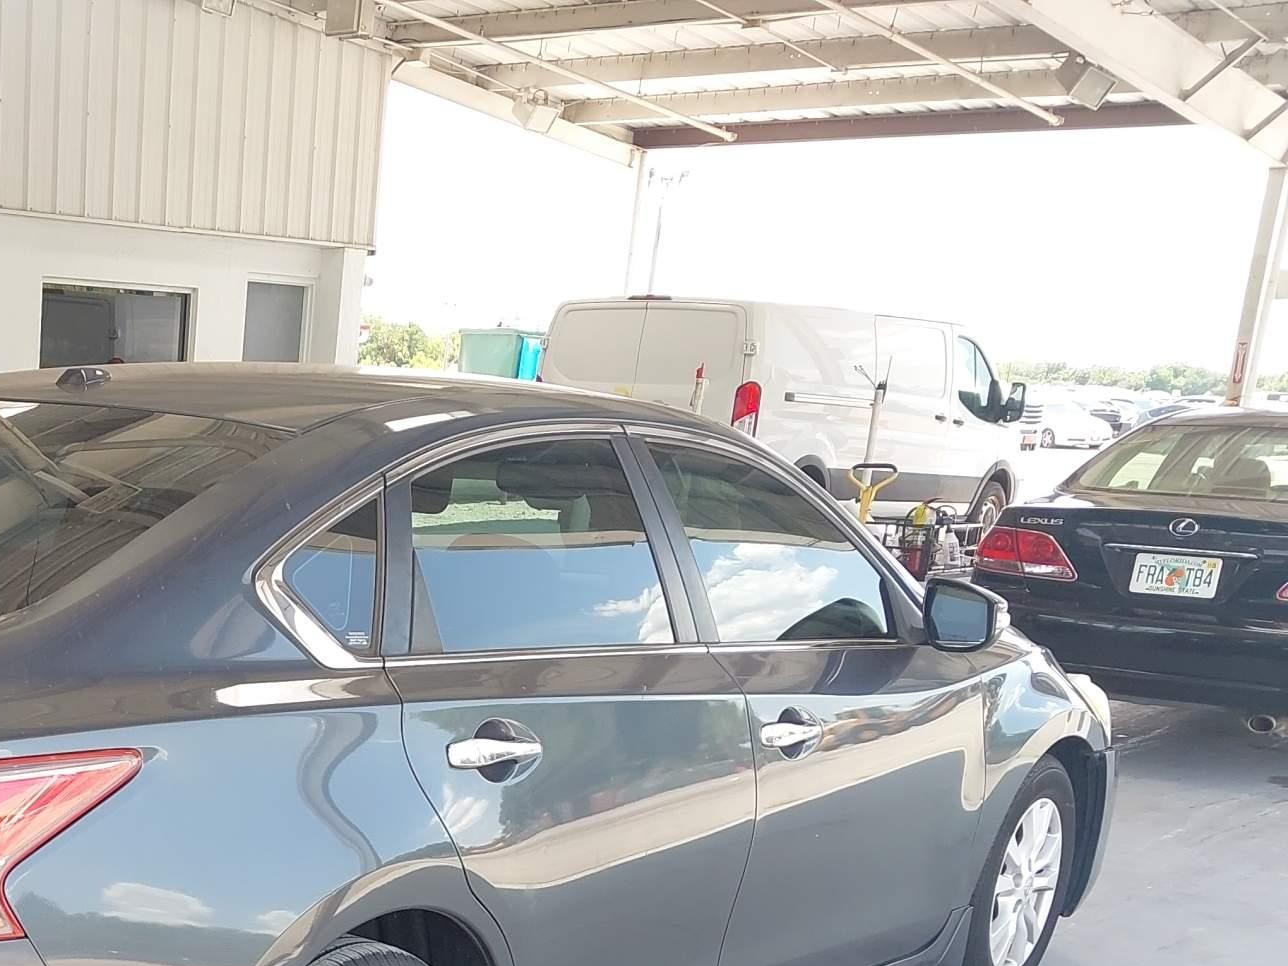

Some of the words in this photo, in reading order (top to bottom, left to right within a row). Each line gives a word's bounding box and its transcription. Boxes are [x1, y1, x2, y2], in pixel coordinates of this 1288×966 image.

[1020, 516, 1064, 526] LEXUS
[1136, 564, 1165, 585] FRA
[1148, 585, 1175, 593] SUNSHINE
[1178, 587, 1196, 595] STATE
